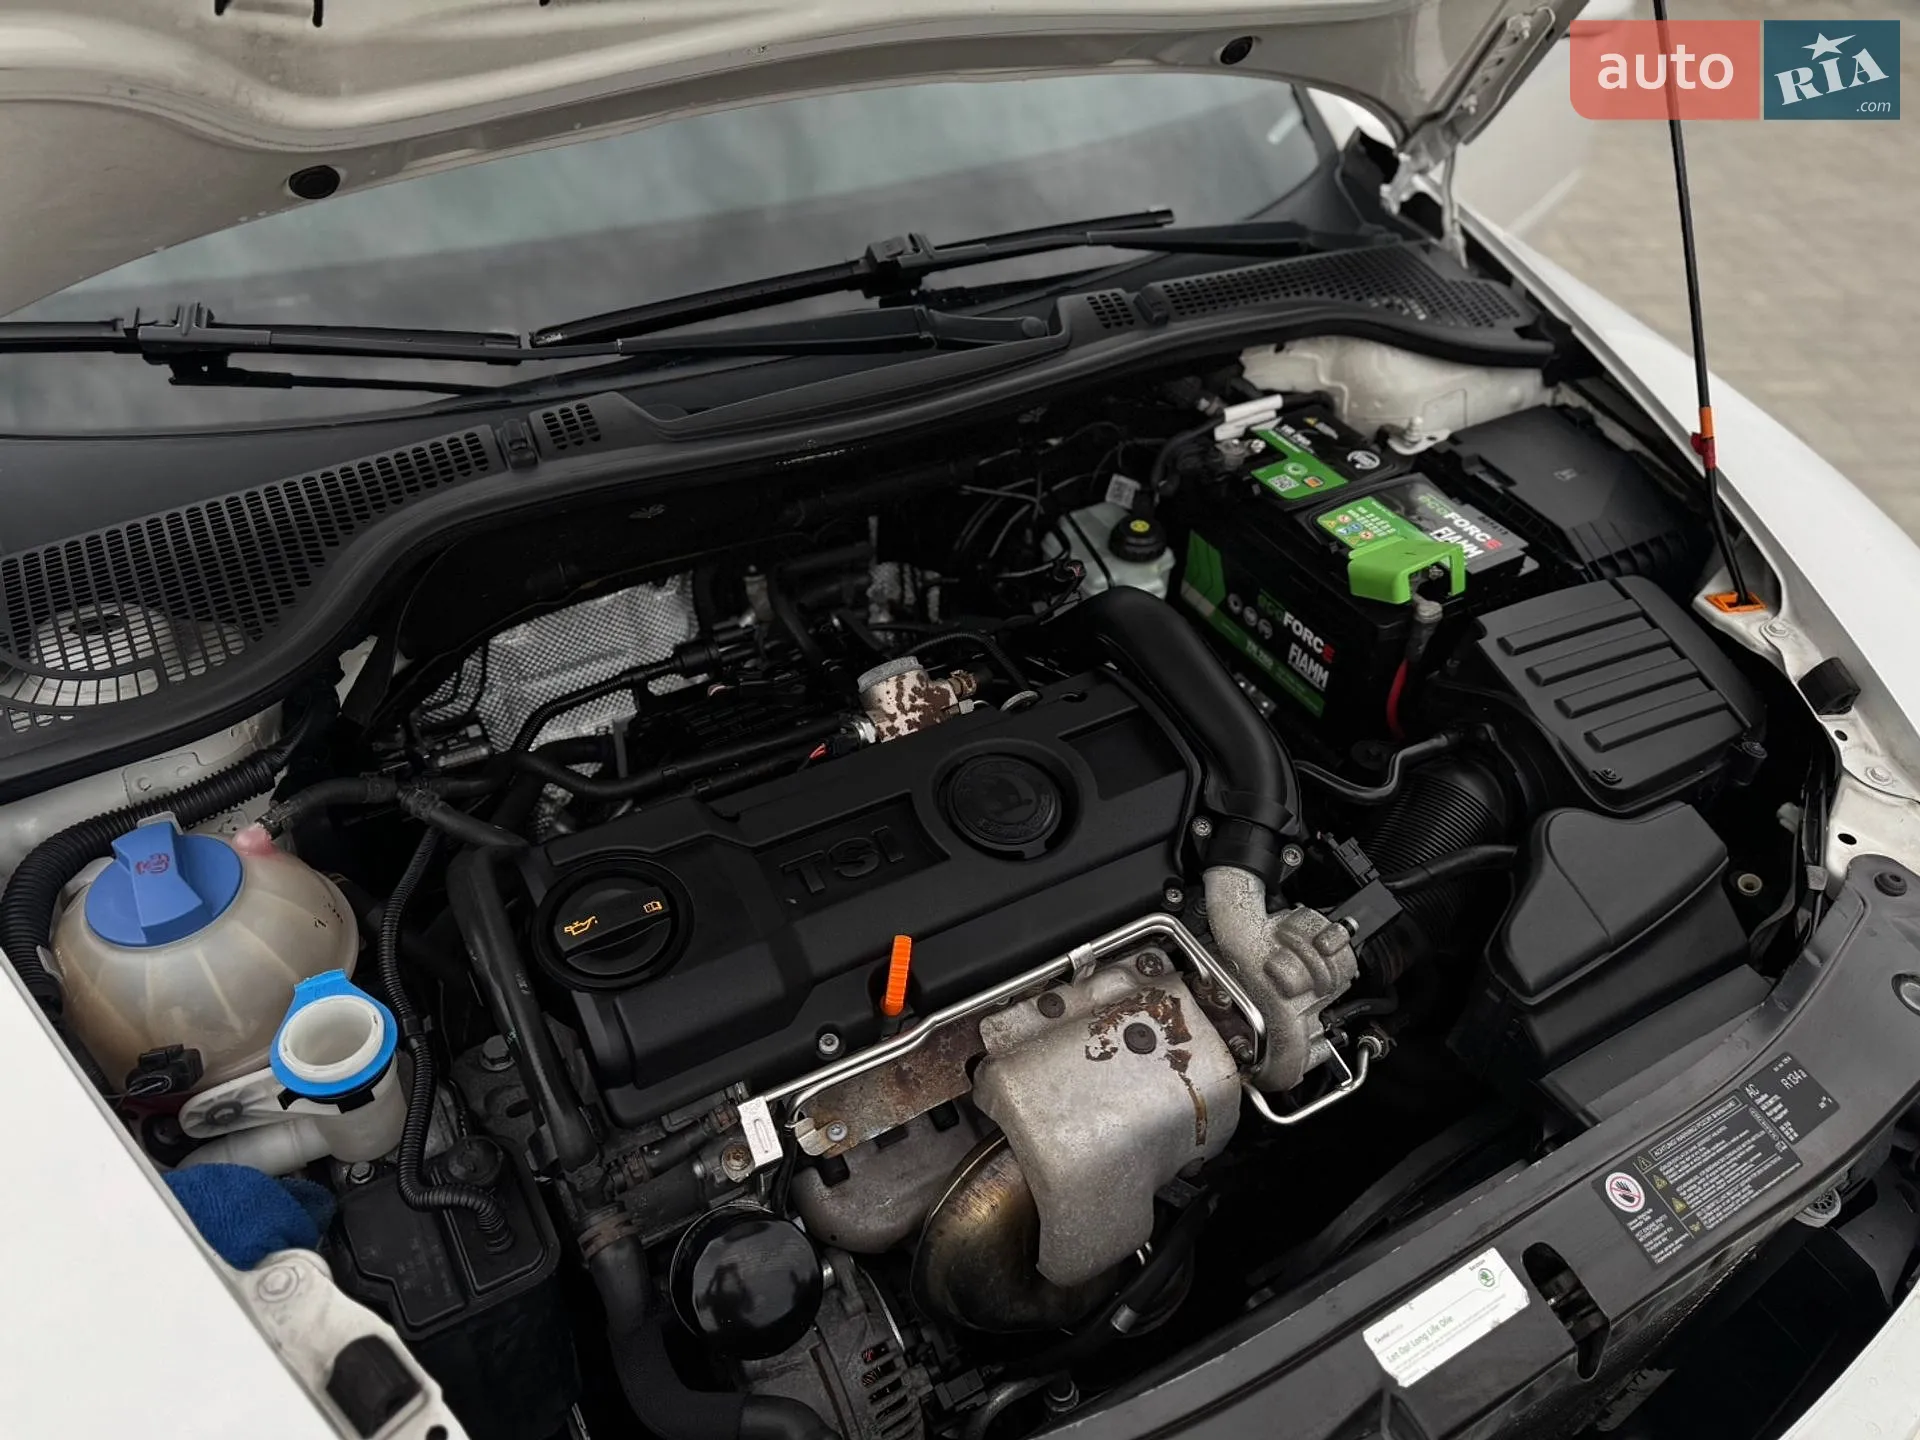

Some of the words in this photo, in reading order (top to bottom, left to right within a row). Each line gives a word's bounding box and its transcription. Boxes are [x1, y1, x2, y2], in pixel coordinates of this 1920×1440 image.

[1288, 642, 1329, 688] FIAMM
[779, 826, 905, 894] TSI
[1745, 1083, 1760, 1098] AC
